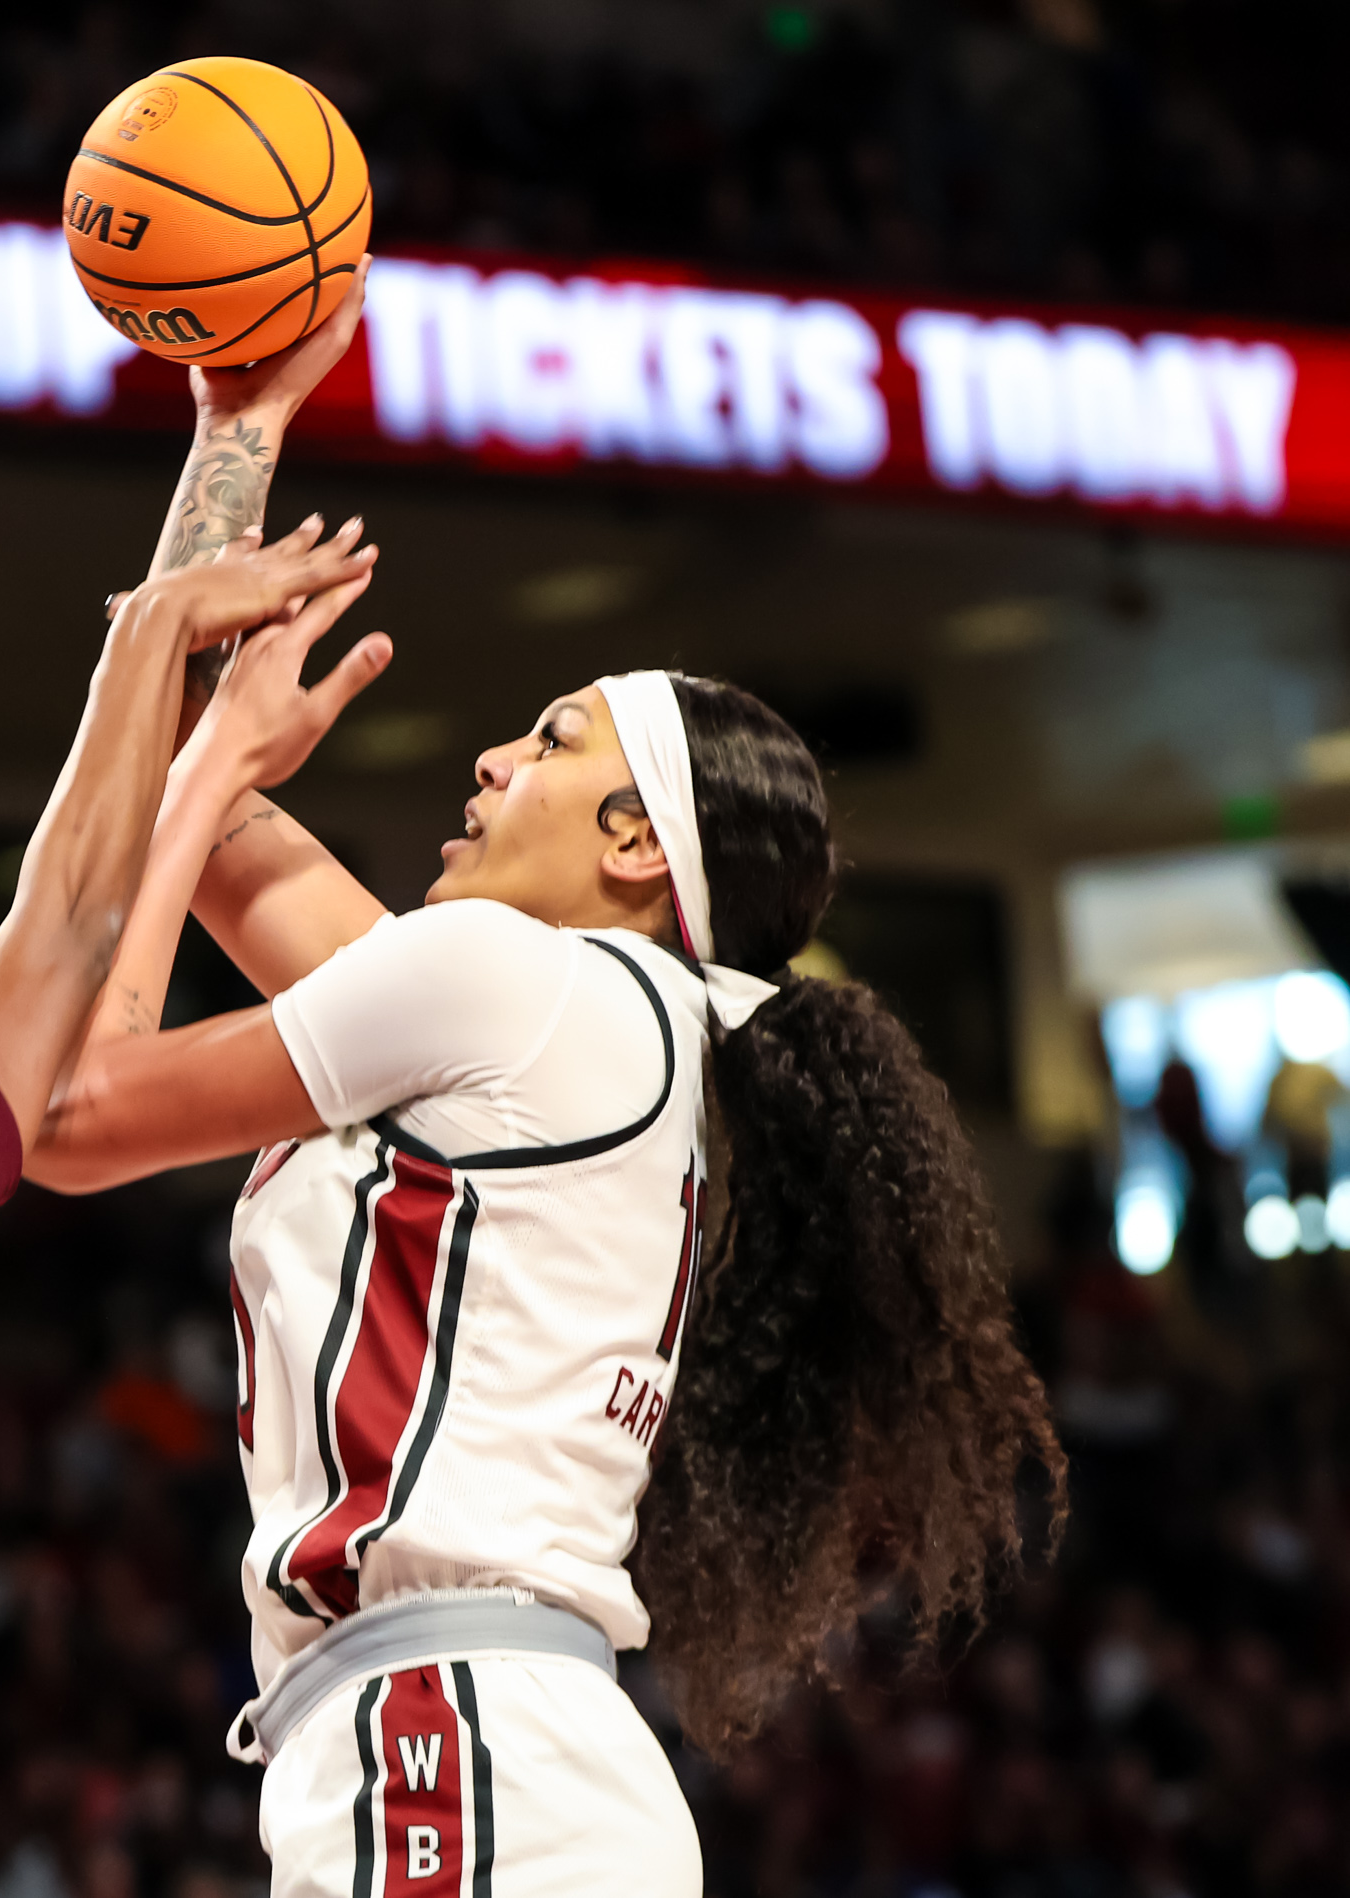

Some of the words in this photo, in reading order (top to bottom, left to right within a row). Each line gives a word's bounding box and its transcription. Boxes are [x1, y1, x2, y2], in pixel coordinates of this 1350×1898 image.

[69, 190, 151, 251] EVO
[364, 256, 889, 476] TICKETS
[897, 309, 1296, 512] TODAY
[605, 1366, 668, 1447] CAR
